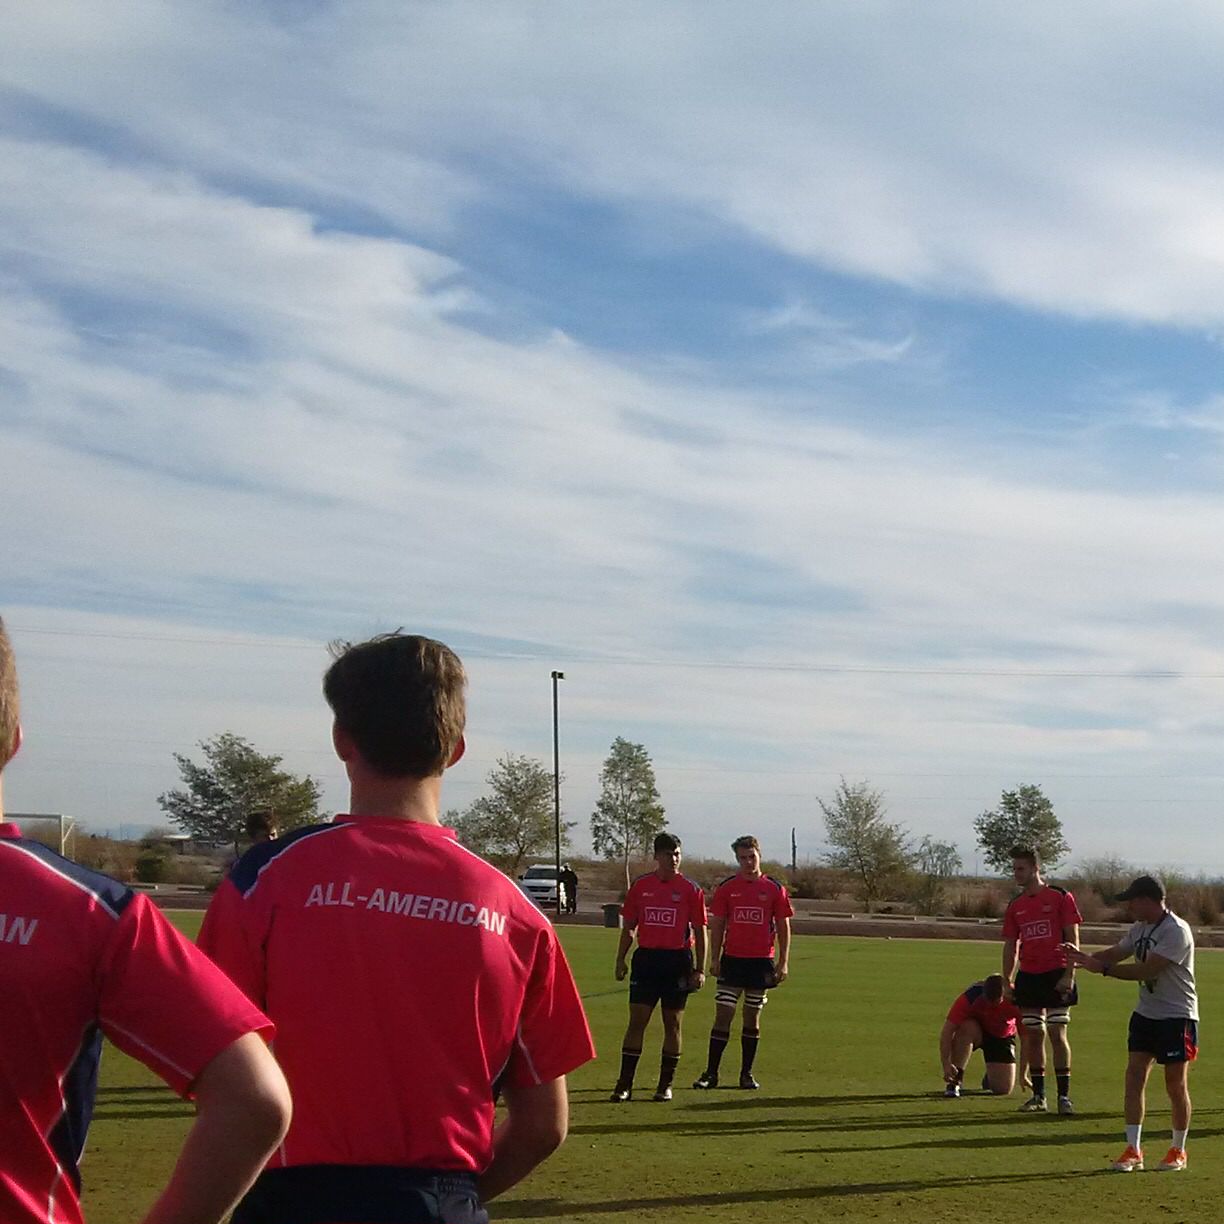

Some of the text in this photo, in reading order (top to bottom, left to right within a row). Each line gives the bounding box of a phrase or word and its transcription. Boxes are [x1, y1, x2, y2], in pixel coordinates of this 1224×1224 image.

[304, 882, 506, 936] ALL-AMERICAN
[648, 909, 673, 923] AIG
[736, 909, 761, 920] AIG
[1026, 923, 1048, 937] AIG
